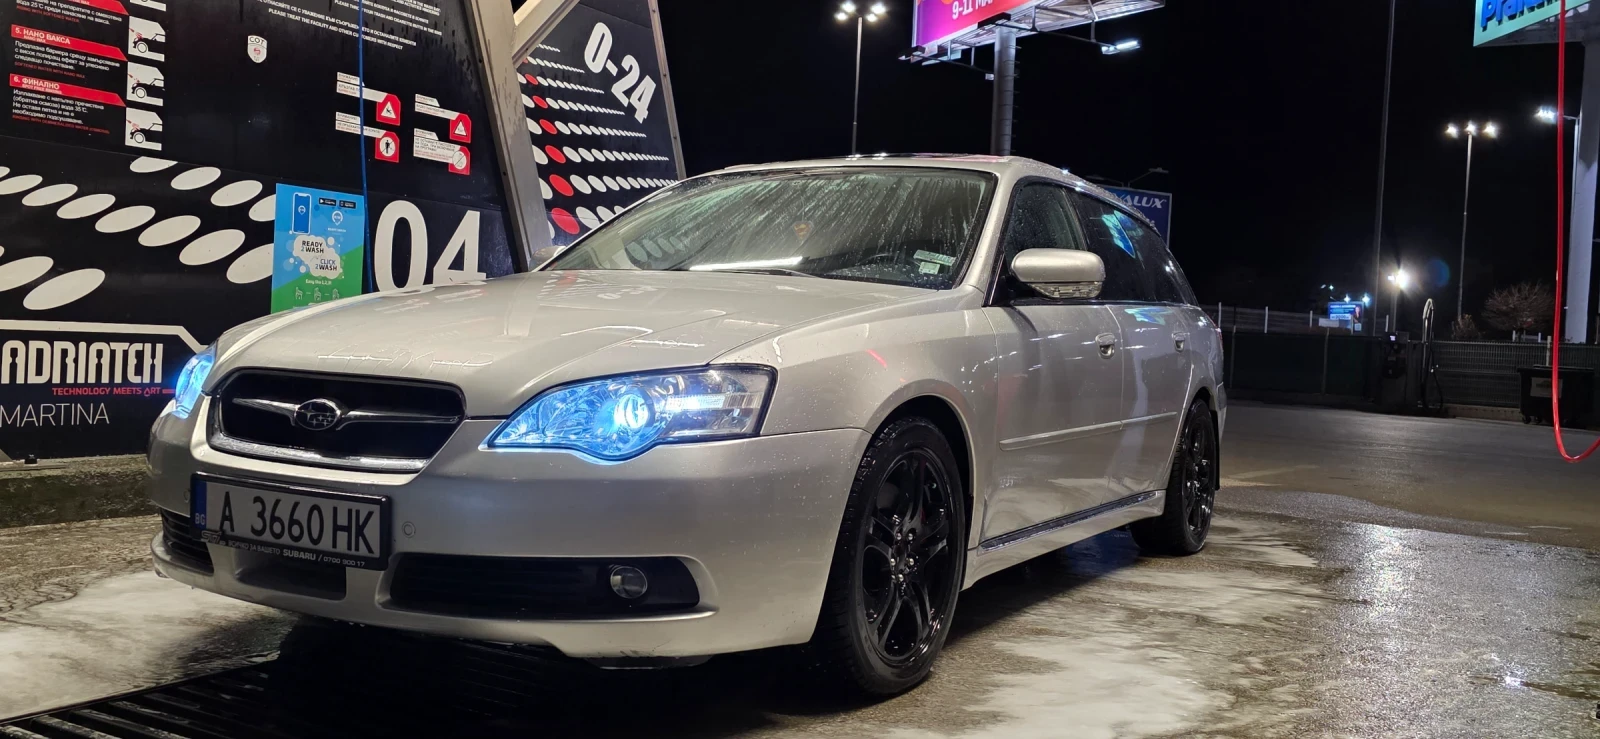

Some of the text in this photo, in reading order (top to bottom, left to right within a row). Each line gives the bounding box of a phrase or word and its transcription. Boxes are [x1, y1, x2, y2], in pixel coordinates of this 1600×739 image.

[269, 7, 287, 17] PLEASE
[23, 29, 45, 39] НАНО
[46, 33, 71, 45] ВАКСА
[584, 22, 656, 124] 0-24
[22, 77, 60, 90] ФИНАЛНО
[302, 240, 324, 248] READY
[374, 200, 487, 292] 04
[321, 258, 336, 266] CLICK
[52, 386, 162, 397] TECHNOLOGY MEETS ART
[0, 402, 110, 428] MARTINA
[195, 512, 206, 526] BG
[219, 491, 375, 555] A 3660 HK
[283, 549, 317, 561] SUBARU
[324, 556, 341, 565] 0700
[342, 558, 356, 566] 900
